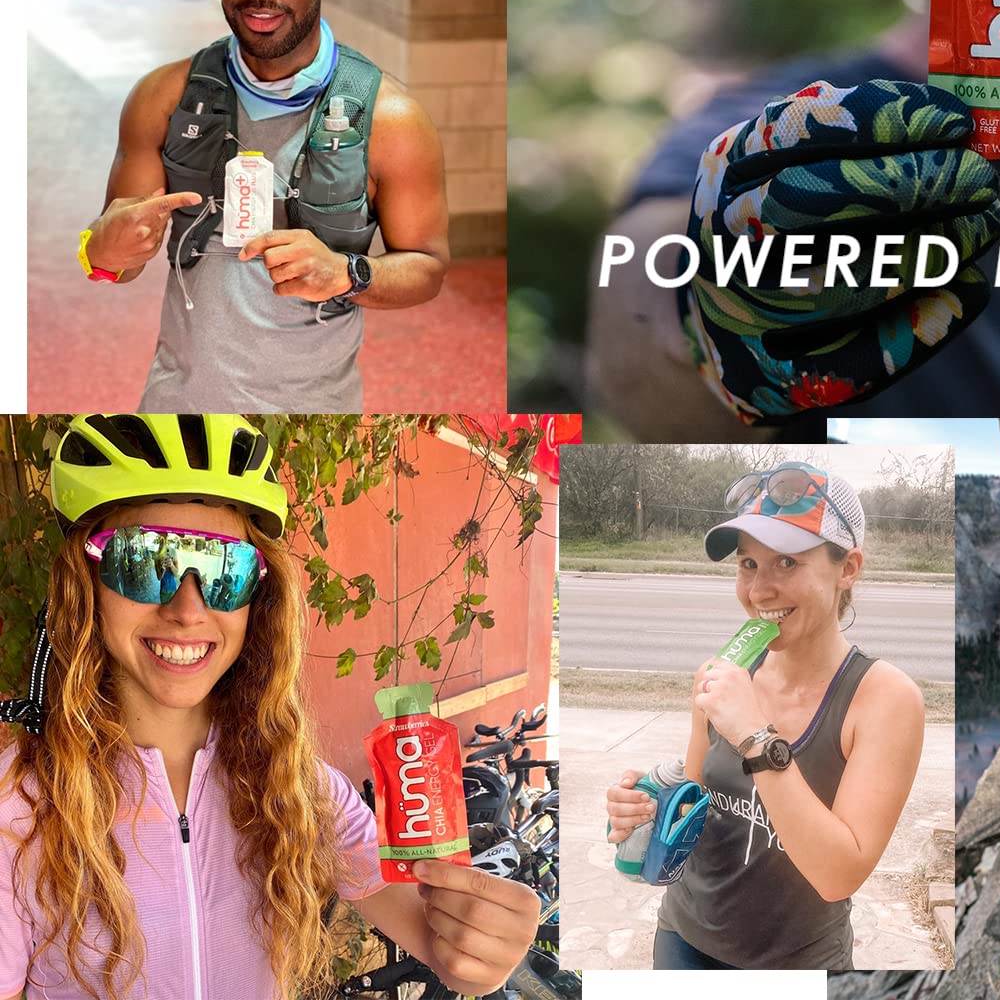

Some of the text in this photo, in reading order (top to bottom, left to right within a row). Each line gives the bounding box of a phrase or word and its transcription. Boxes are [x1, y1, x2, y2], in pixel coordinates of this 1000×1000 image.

[954, 84, 986, 99] 100%
[971, 143, 989, 152] NET
[427, 760, 442, 805] ENERGY
[435, 808, 446, 836] CHIA
